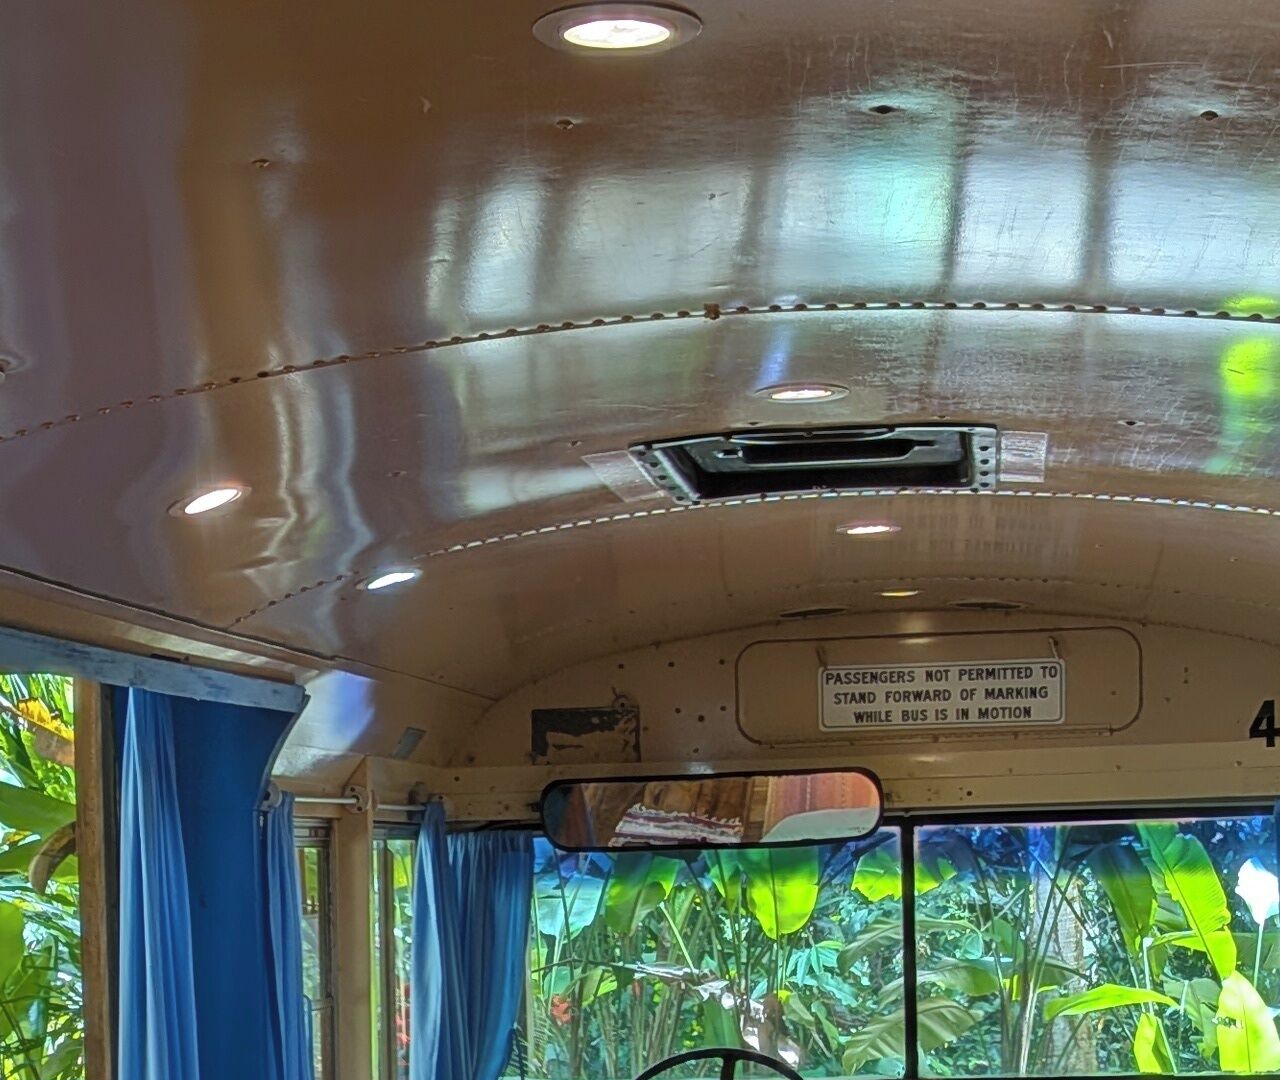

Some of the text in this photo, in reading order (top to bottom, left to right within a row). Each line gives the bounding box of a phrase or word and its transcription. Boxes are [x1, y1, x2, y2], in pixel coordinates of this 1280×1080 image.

[825, 665, 1058, 685] PASSENGERS NOT PERMITTED TO
[833, 685, 1049, 706] STAND FORWARD OF MARKING
[853, 705, 1032, 724] WHILE BUS IS IN MOTION
